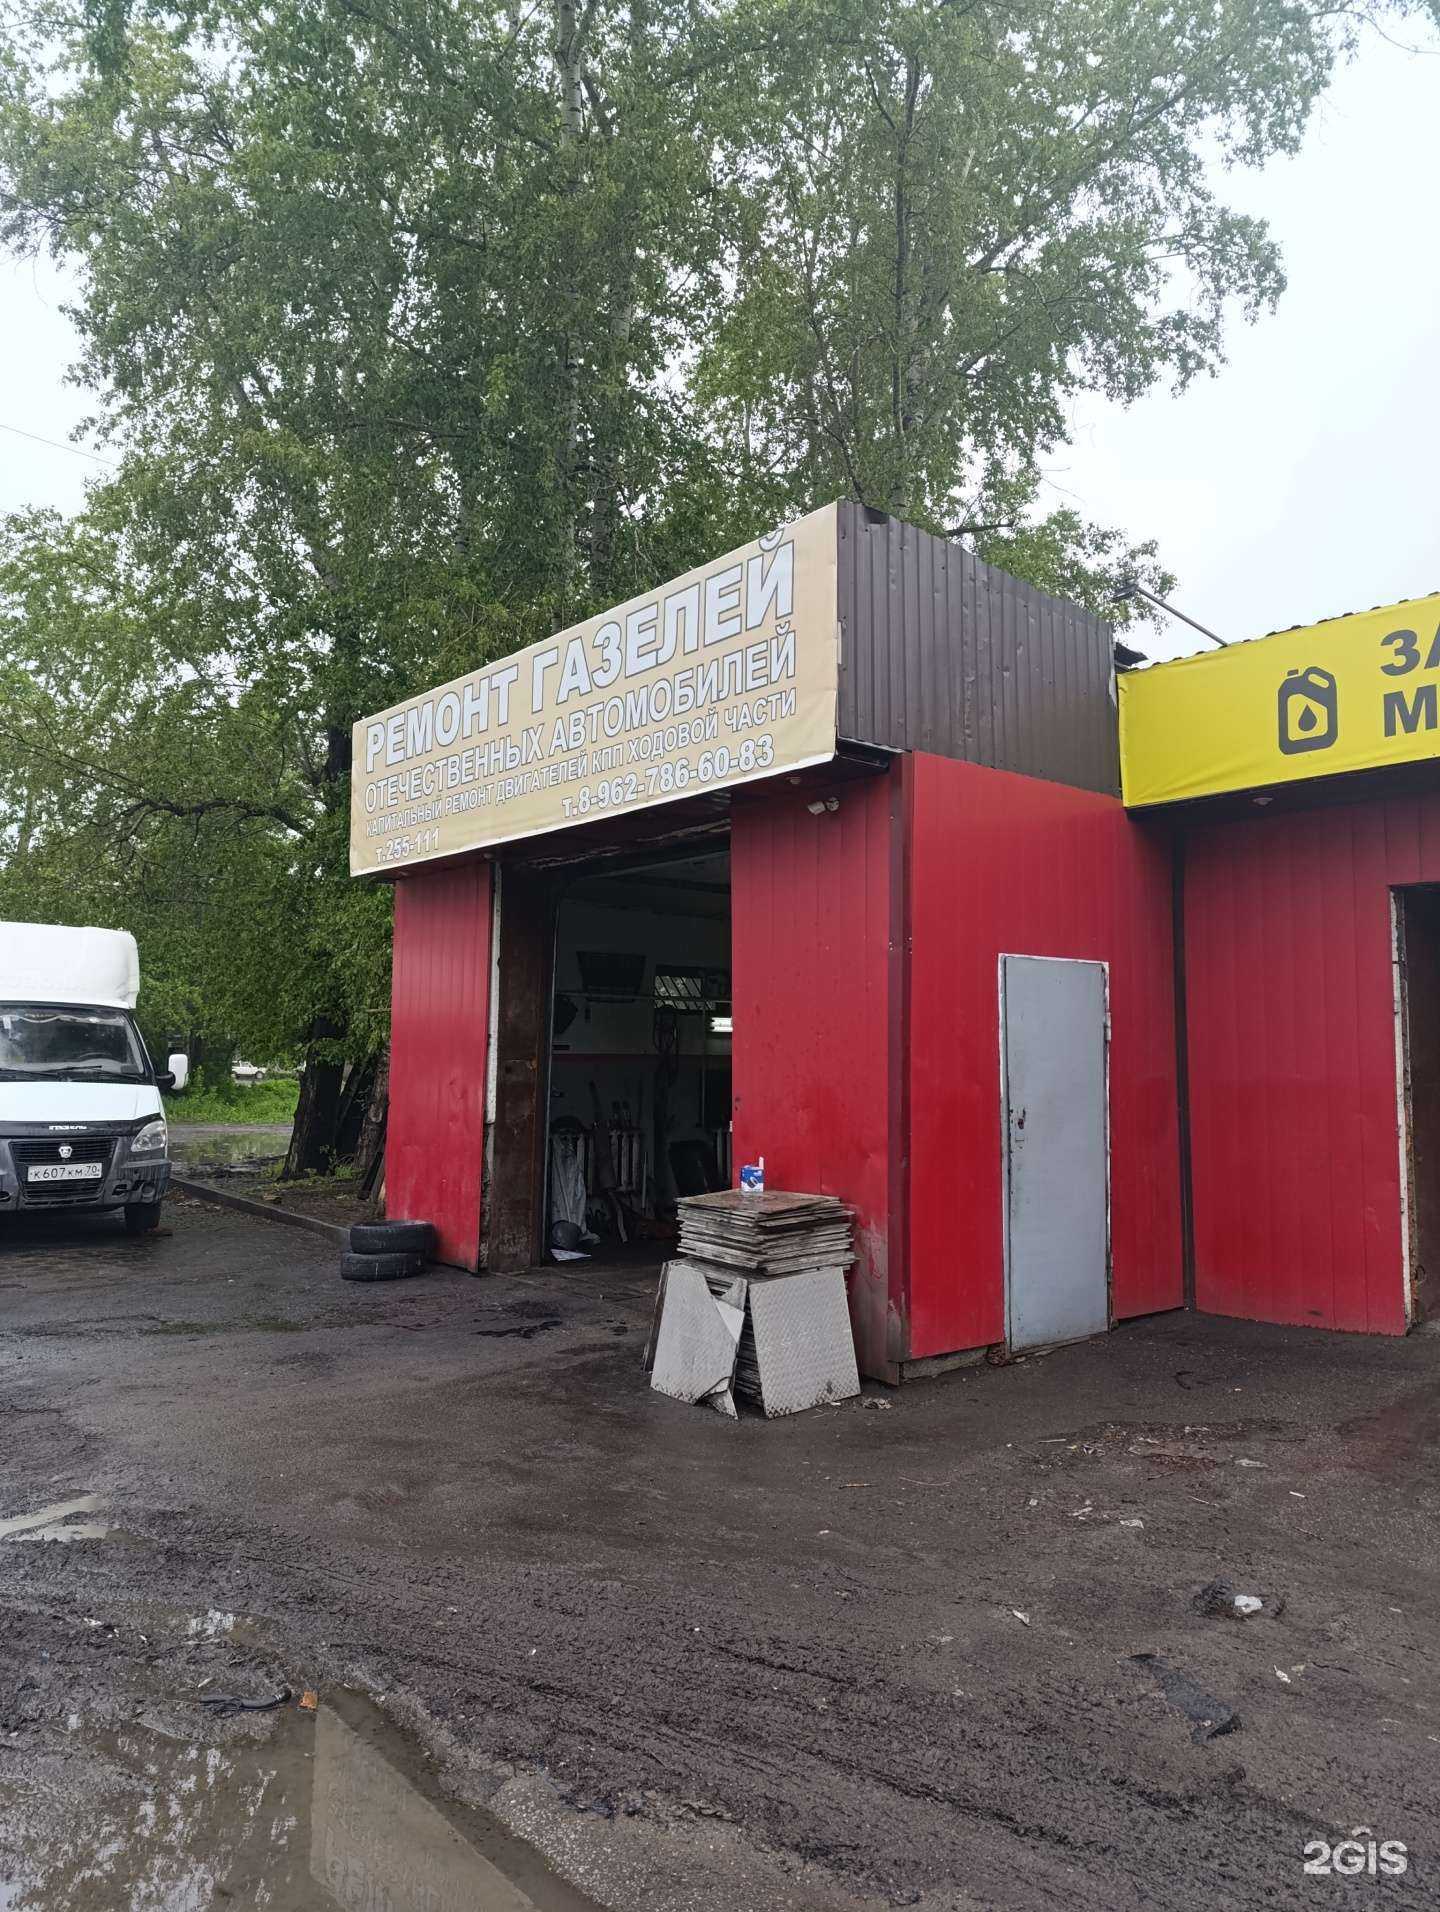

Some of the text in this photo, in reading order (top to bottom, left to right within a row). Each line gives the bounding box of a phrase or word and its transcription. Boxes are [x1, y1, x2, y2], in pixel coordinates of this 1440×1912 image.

[365, 620, 796, 813] ОТЕЧЕСТВЕННЫХ АВТОМОБИЛЕЙ
[366, 529, 795, 774] РЕМОНТ ГАЗЕЛЕЙ
[366, 687, 796, 838] КАПИТАЛЬНЫЙ РЕМОНТ ДВИГАТЕЛЕЙ КПП ХОДОВОЙ ЧАСТИ
